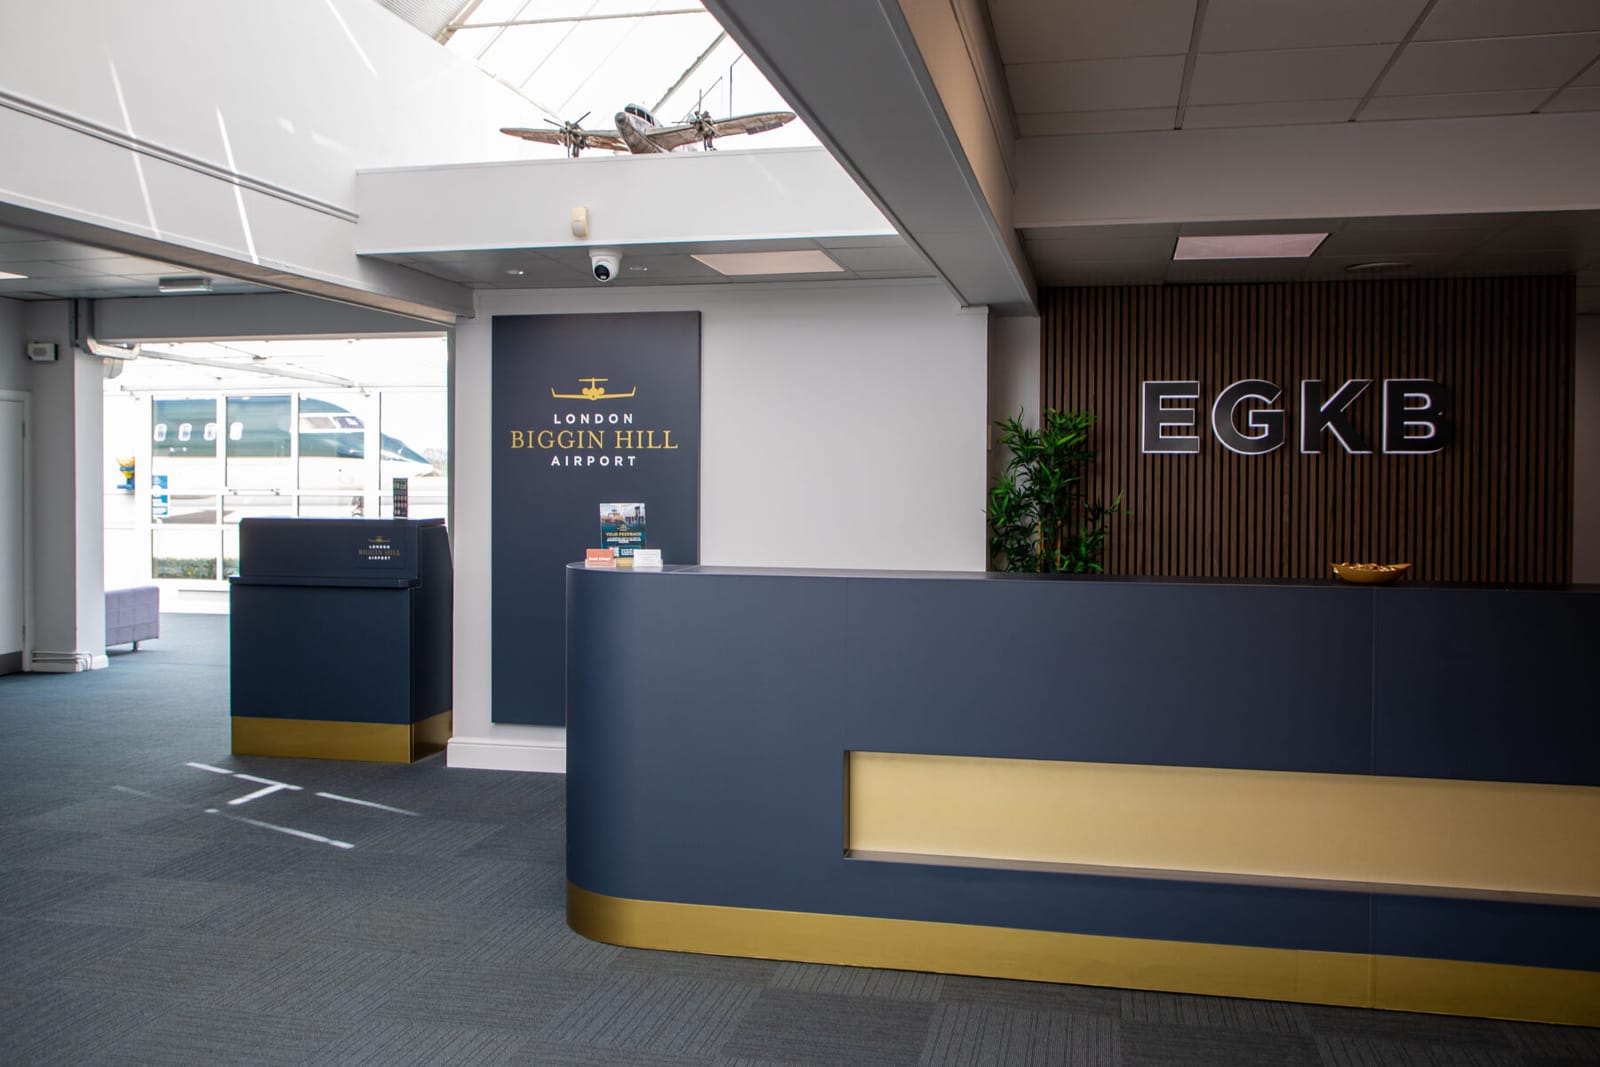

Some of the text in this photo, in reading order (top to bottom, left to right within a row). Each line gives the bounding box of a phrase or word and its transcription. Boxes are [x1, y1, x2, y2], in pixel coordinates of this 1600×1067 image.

[553, 413, 634, 425] LONDON
[1142, 378, 1450, 455] EGKB
[510, 429, 679, 449] BIGGIN HILL
[551, 455, 637, 467] AIRPORT
